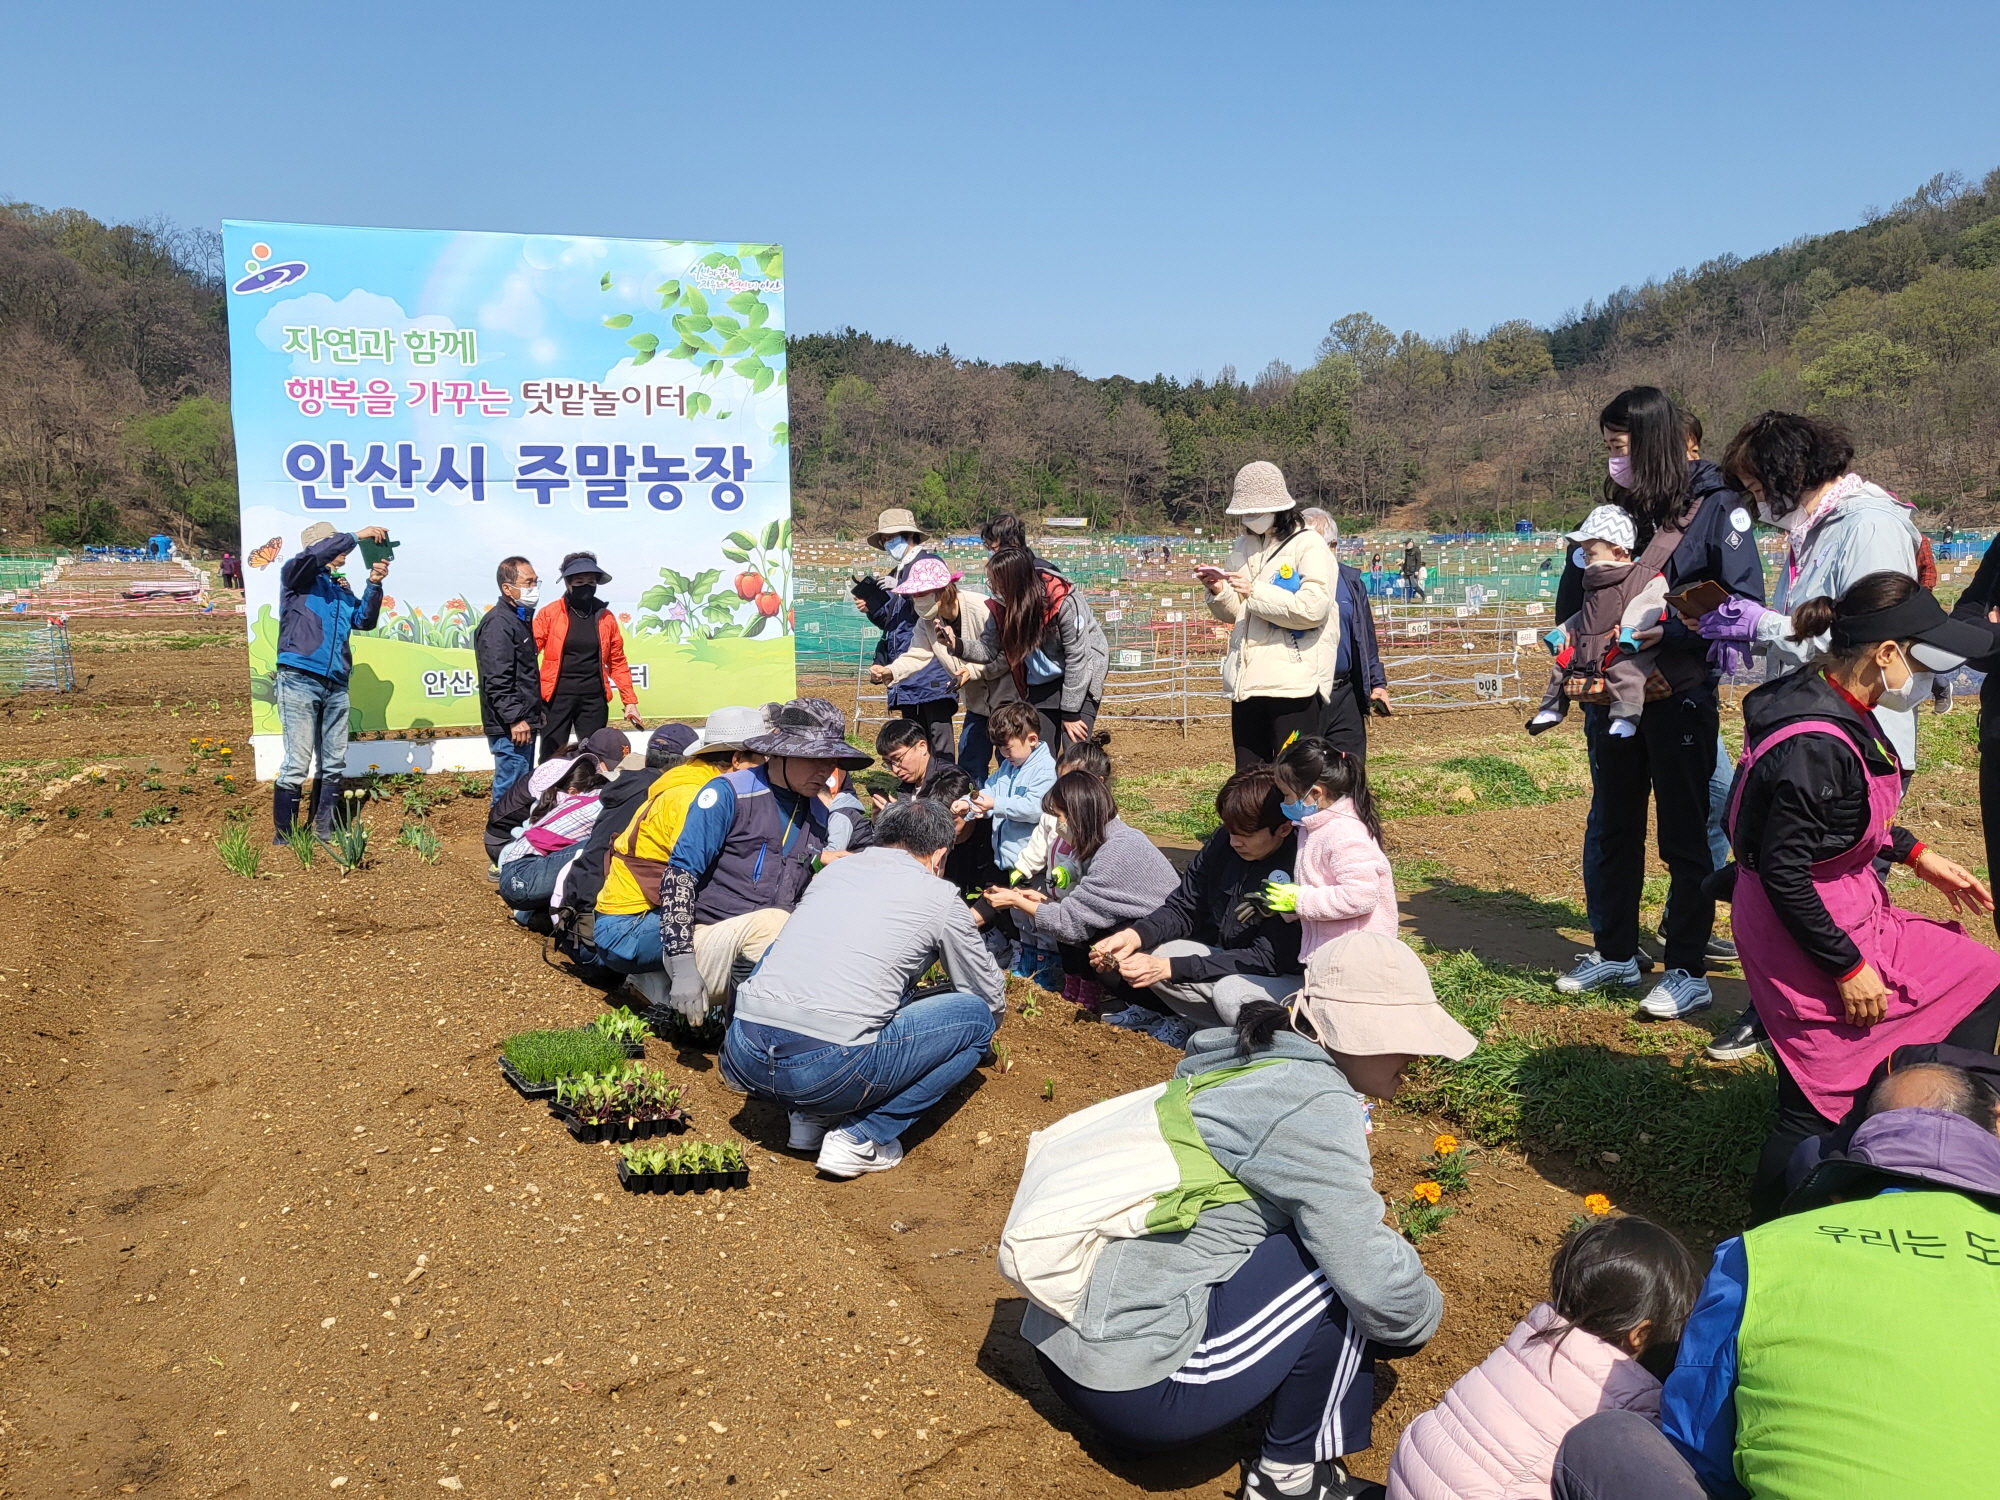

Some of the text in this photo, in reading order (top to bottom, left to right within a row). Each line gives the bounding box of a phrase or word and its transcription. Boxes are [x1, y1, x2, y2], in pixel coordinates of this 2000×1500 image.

[283, 326, 478, 364] 자연과 함께
[286, 377, 687, 417] 행복을 가꾸는 텃밭놀이터
[285, 443, 753, 512] 안산시 주말농장
[1520, 633, 1532, 641] 601
[423, 670, 480, 696] 안산
[1813, 1224, 1947, 1260] 우리는
